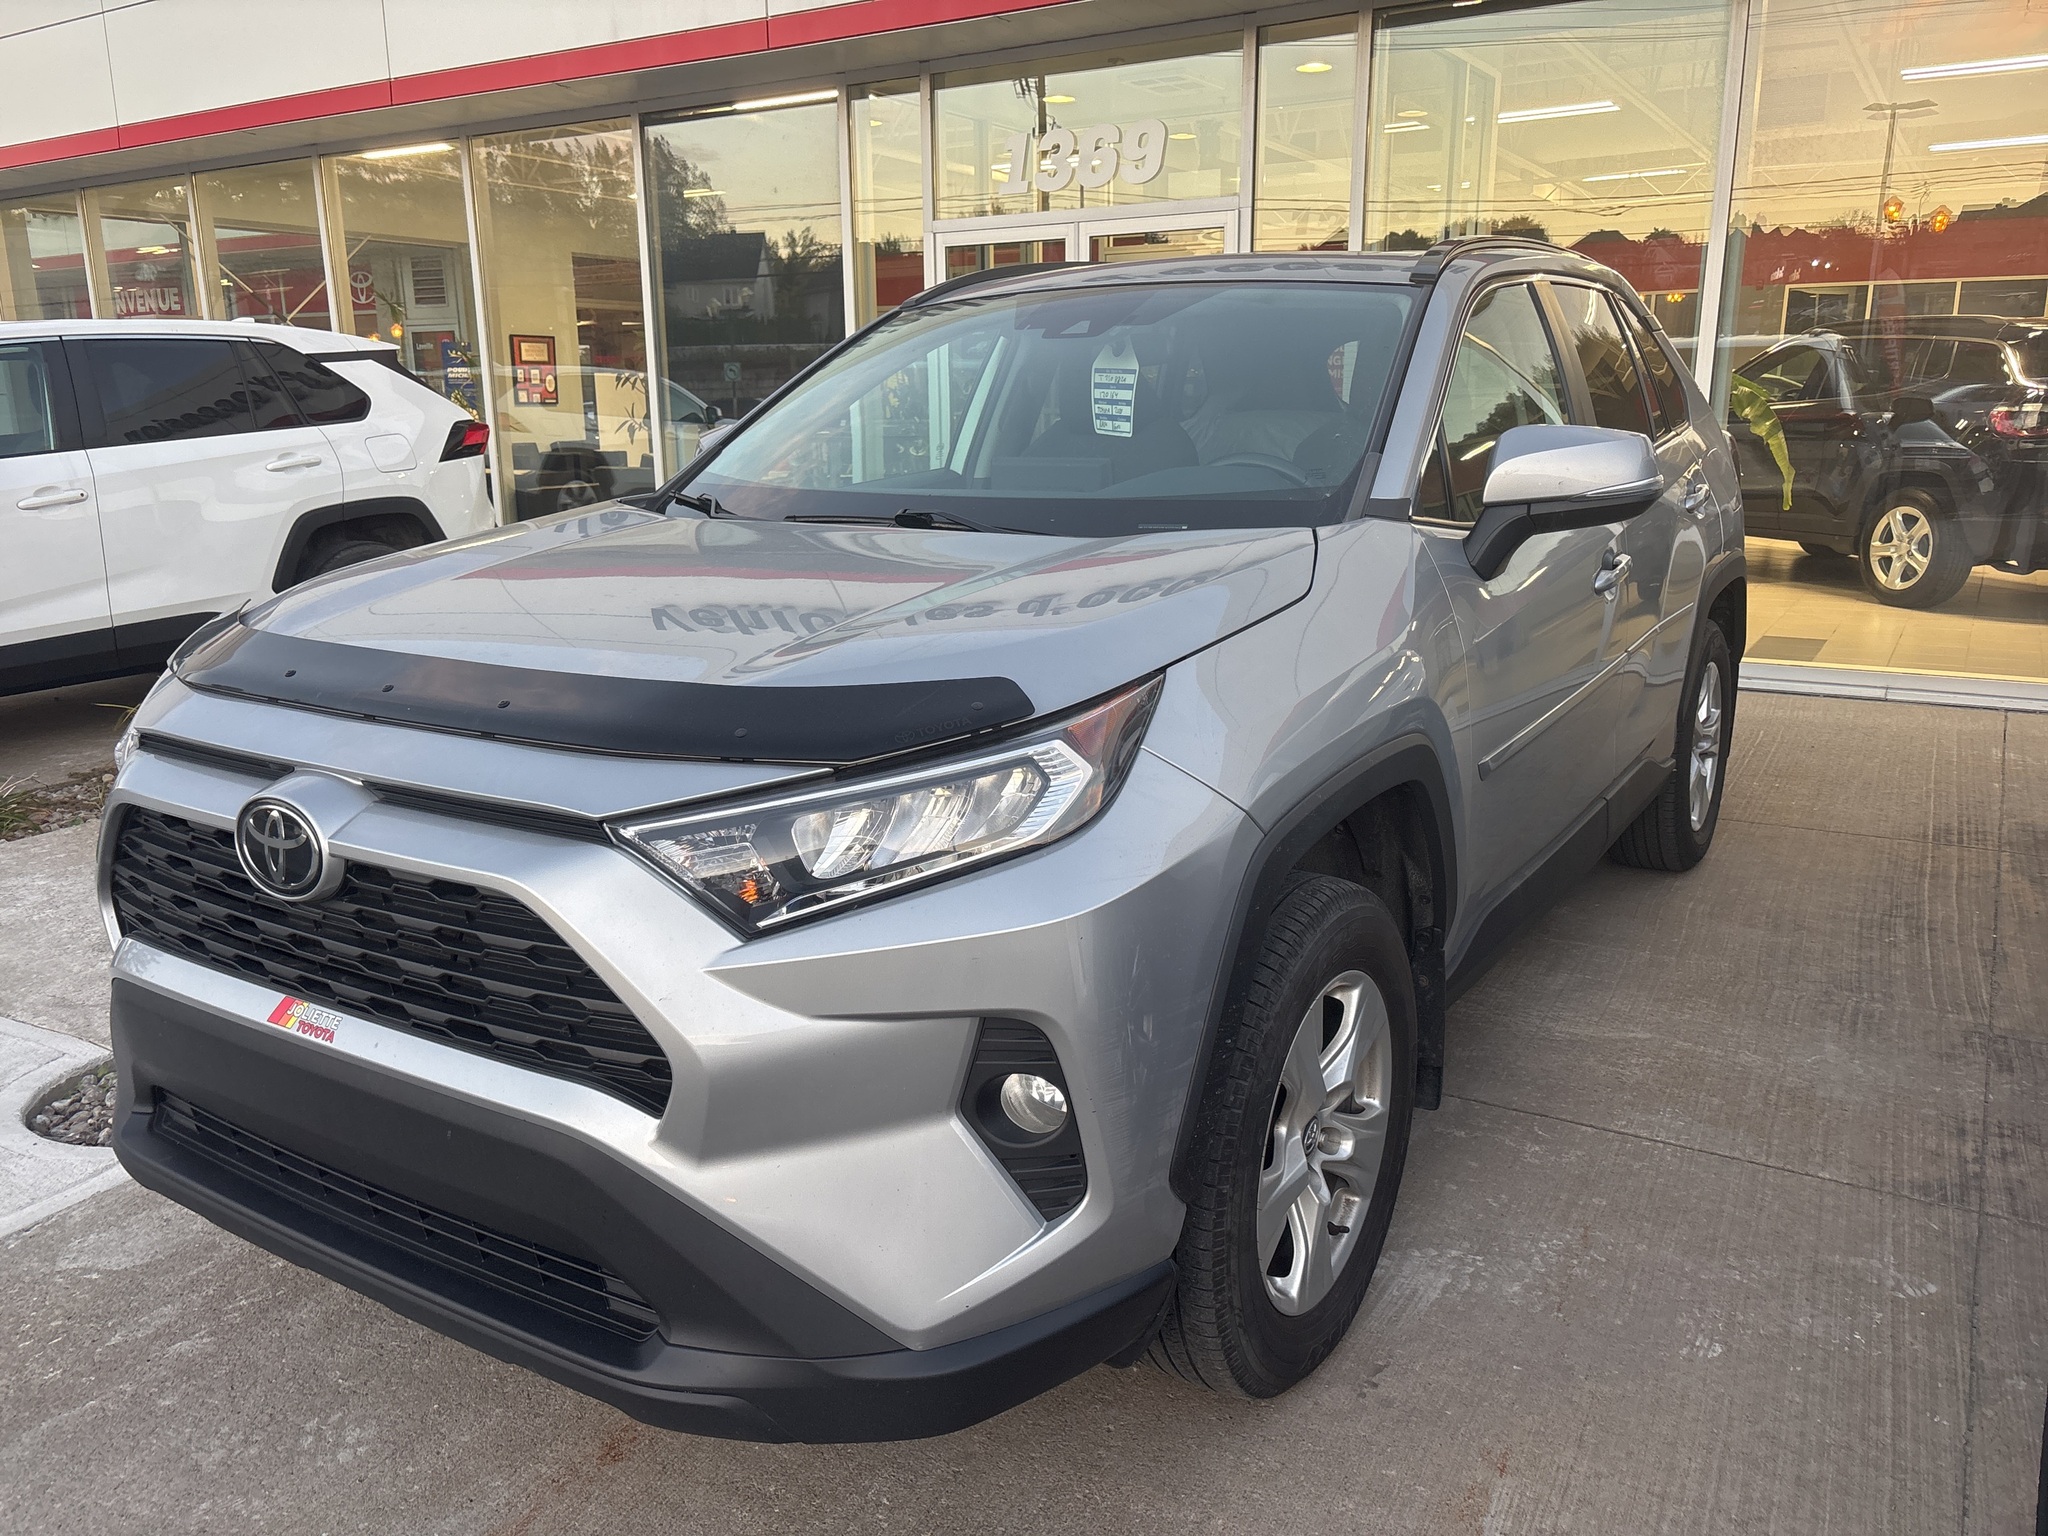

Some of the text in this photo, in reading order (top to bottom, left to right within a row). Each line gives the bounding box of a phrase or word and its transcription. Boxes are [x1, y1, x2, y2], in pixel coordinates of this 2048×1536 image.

[998, 118, 1169, 195] 1369
[916, 717, 972, 737] TOYOTA
[286, 1003, 343, 1030] JOLIETTE
[296, 1020, 335, 1043] TOYOTA
